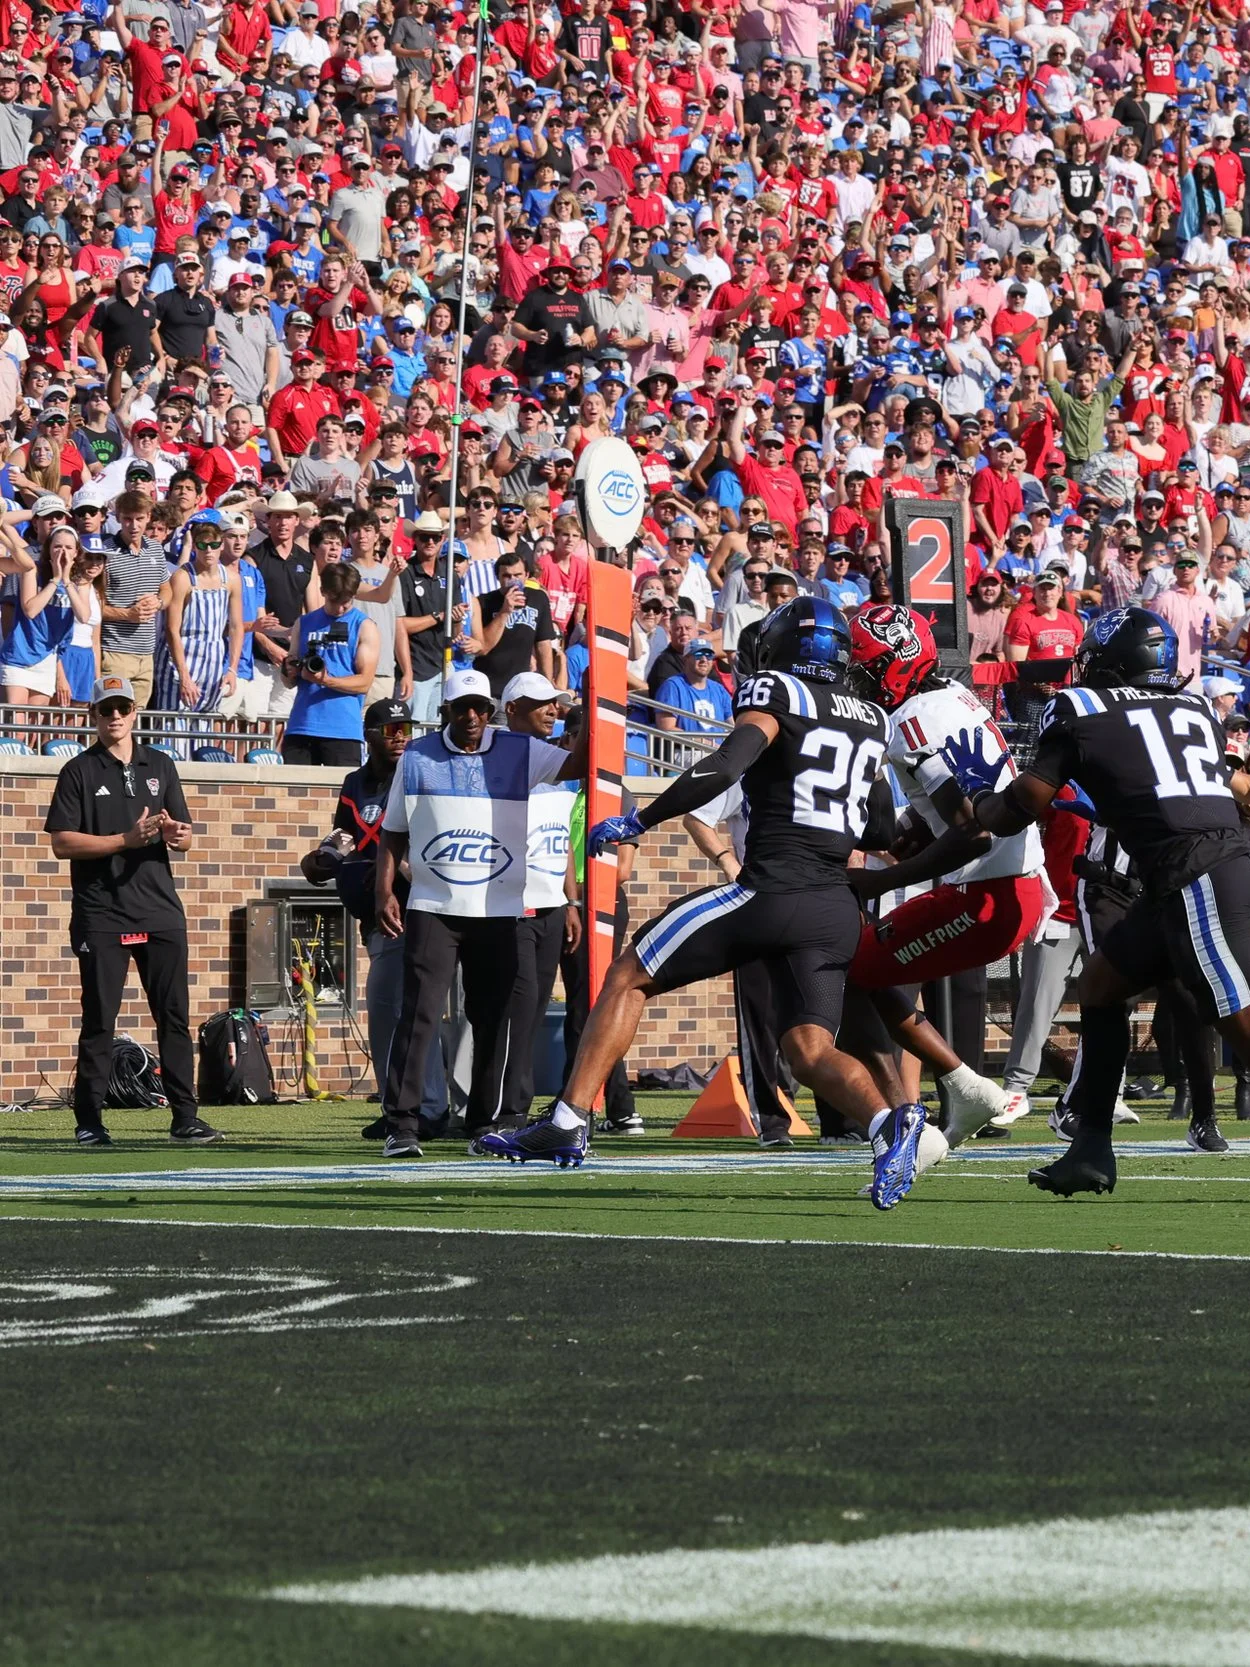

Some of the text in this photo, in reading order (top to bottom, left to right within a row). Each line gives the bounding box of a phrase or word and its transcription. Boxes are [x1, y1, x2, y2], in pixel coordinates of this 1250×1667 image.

[578, 35, 601, 61] 00
[1153, 61, 1171, 76] 23
[799, 184, 822, 207] 87
[1070, 176, 1093, 197] 87
[604, 481, 634, 499] ACC
[908, 518, 954, 604] 2
[493, 605, 539, 631] UKE
[736, 677, 774, 708] 26
[831, 693, 879, 726] JONES
[898, 716, 928, 751] 11
[1125, 708, 1234, 799] 12
[792, 727, 886, 838] 26
[432, 843, 502, 864] ACC
[893, 911, 976, 966] WOLFPACK
